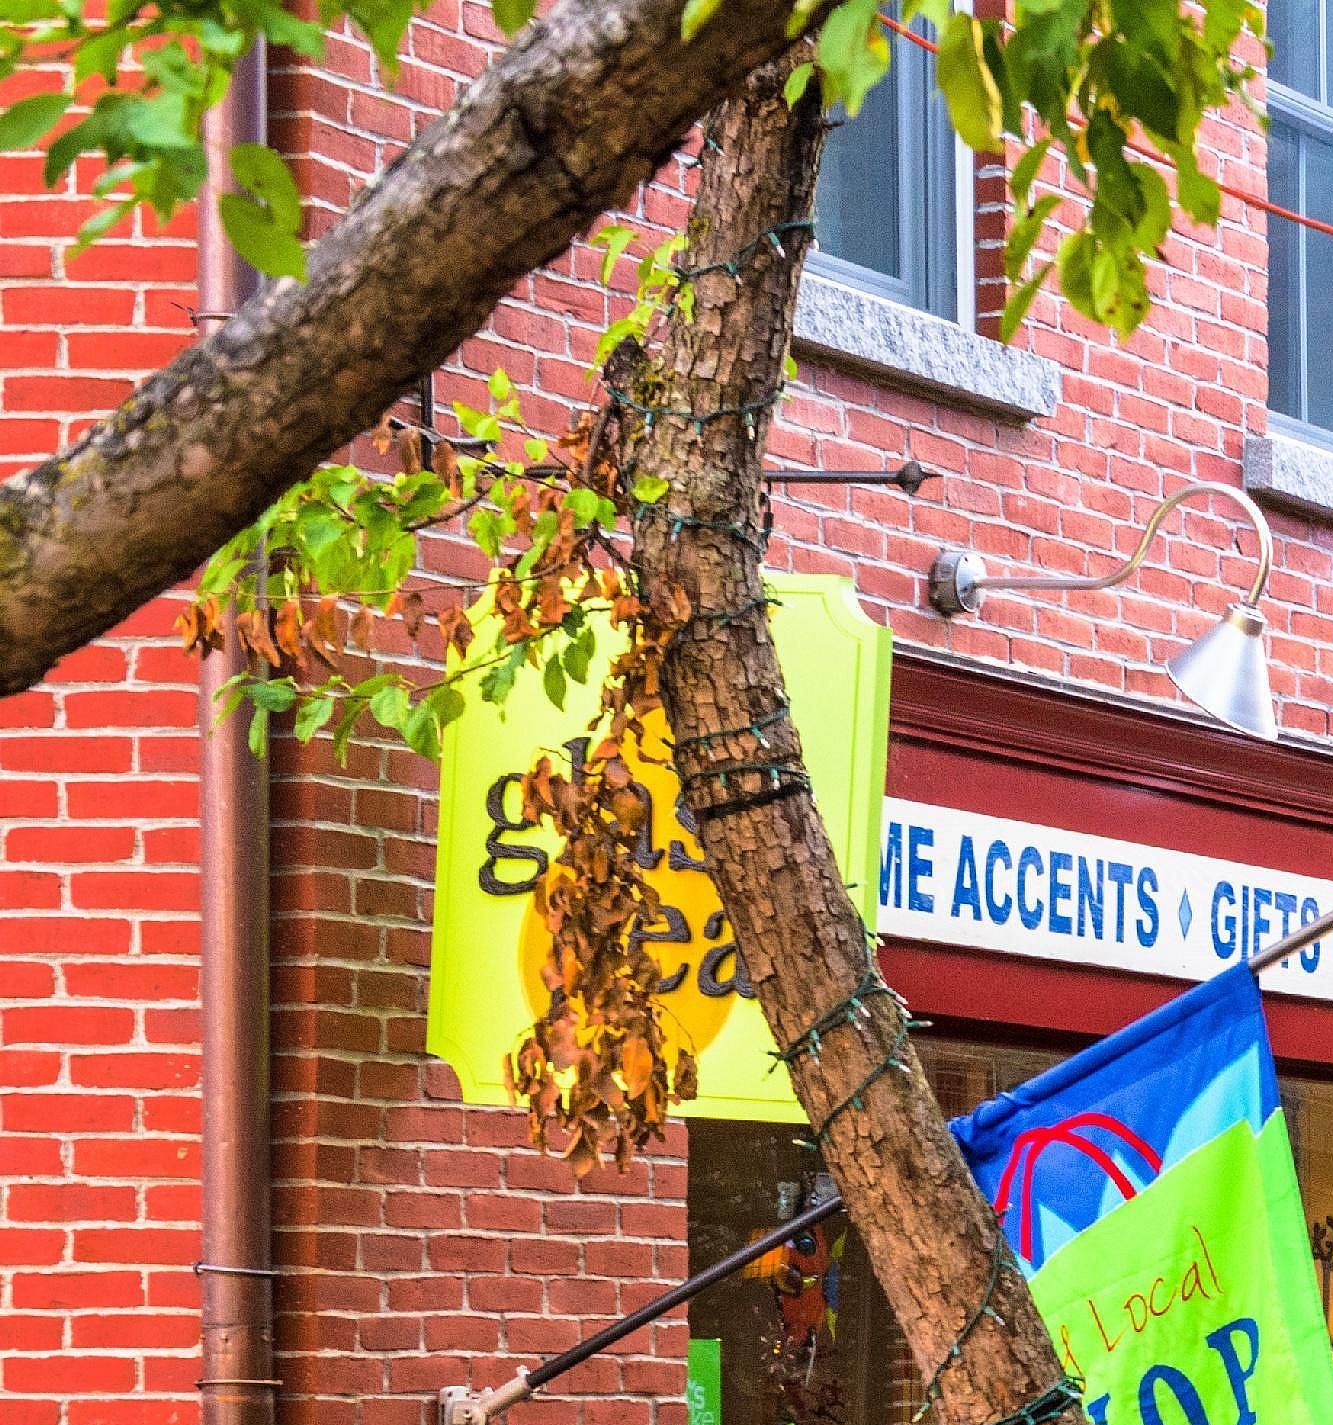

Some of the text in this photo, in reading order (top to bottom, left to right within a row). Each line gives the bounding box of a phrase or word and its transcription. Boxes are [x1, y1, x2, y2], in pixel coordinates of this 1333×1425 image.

[878, 821, 934, 913] ME
[951, 836, 1160, 948] ACCENTS
[1210, 880, 1321, 974] GIFTS
